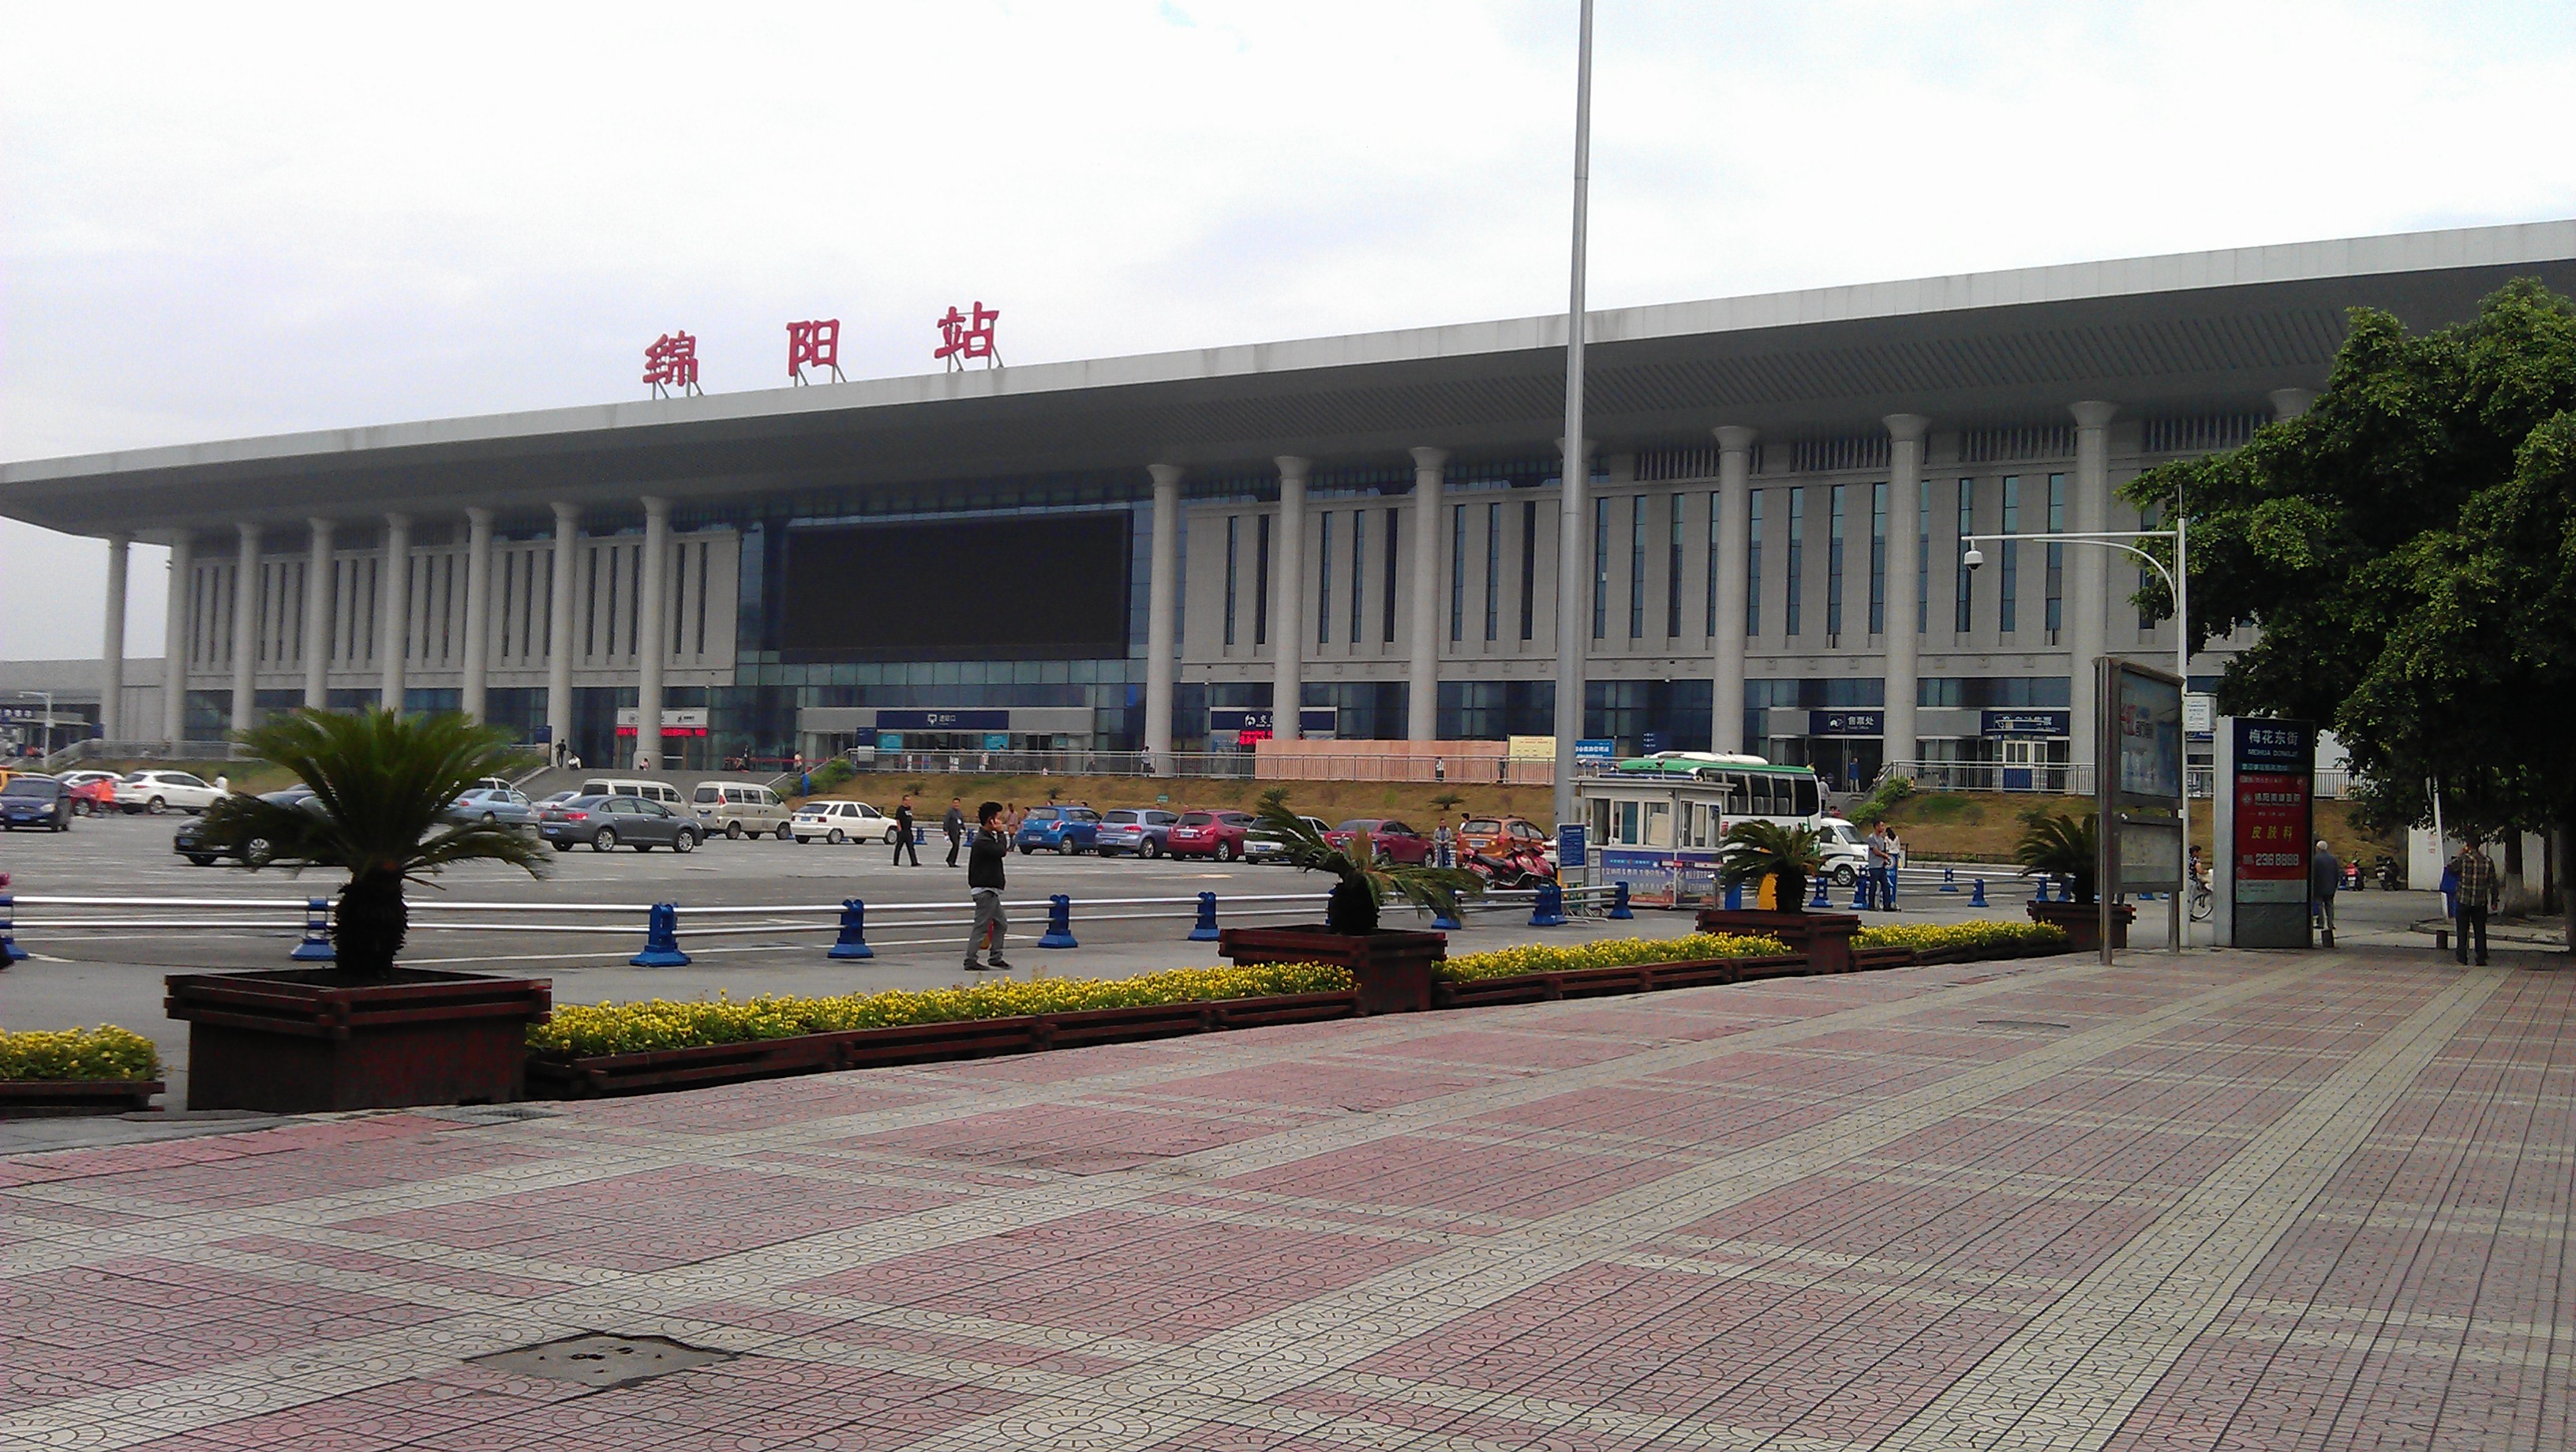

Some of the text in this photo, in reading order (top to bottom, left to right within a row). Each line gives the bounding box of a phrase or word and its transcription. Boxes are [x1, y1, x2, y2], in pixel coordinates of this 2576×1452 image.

[642, 301, 999, 387] 绵阳站
[1848, 716, 1874, 726] 售票处
[2248, 728, 2298, 746] 梅花东街
[2251, 825, 2293, 841] 皮肤科
